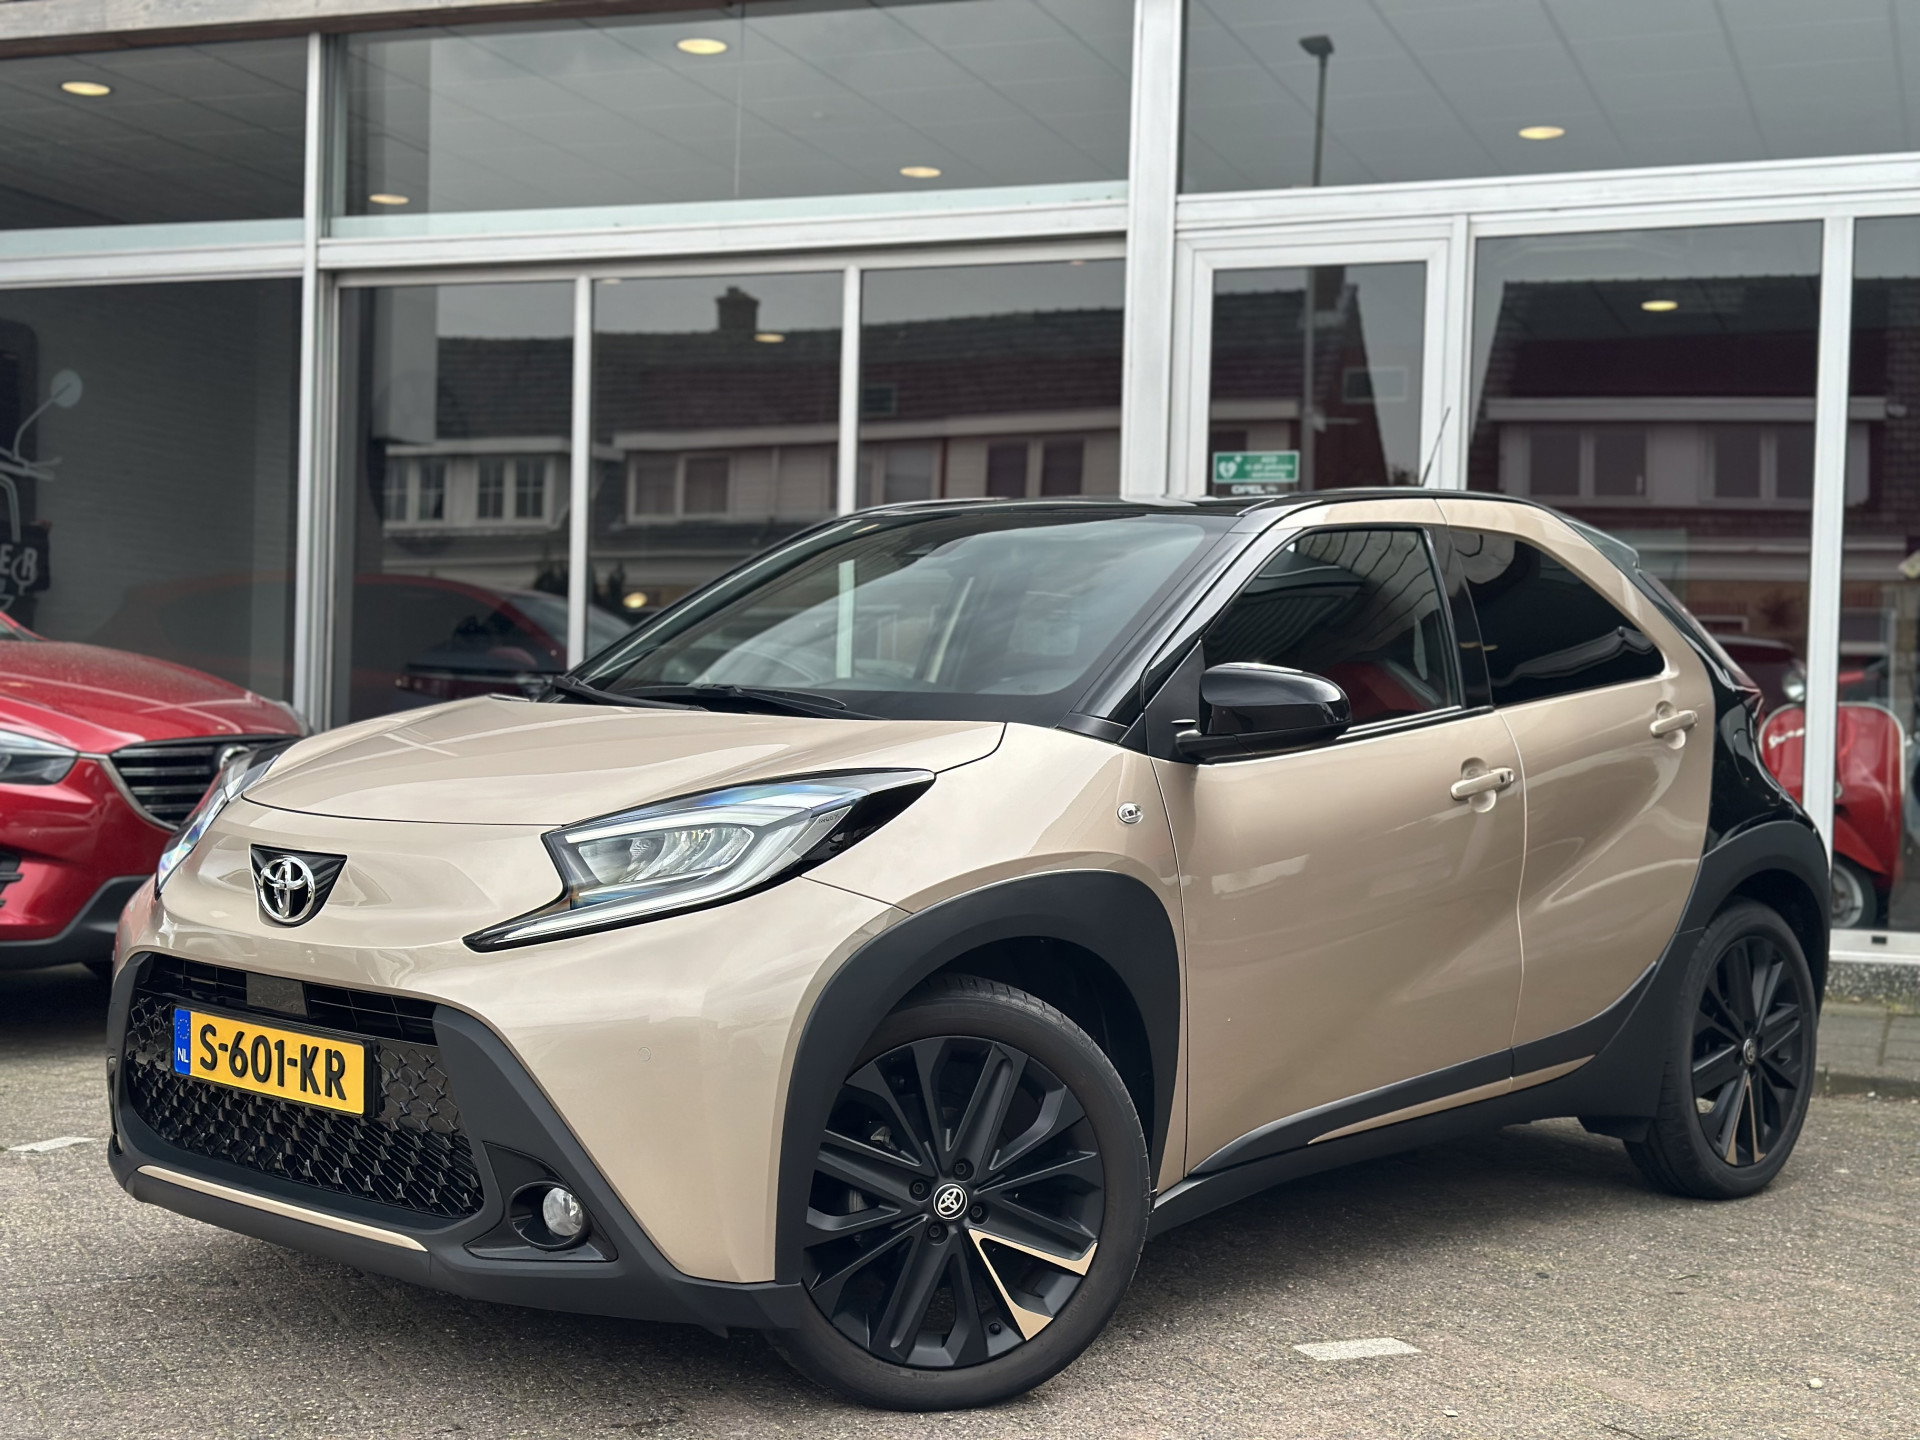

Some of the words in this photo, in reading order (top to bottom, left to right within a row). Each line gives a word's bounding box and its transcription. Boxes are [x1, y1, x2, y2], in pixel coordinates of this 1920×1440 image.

[1231, 485, 1265, 494] OPEL
[177, 1047, 189, 1063] NL
[200, 1023, 347, 1101] S-601-KR
